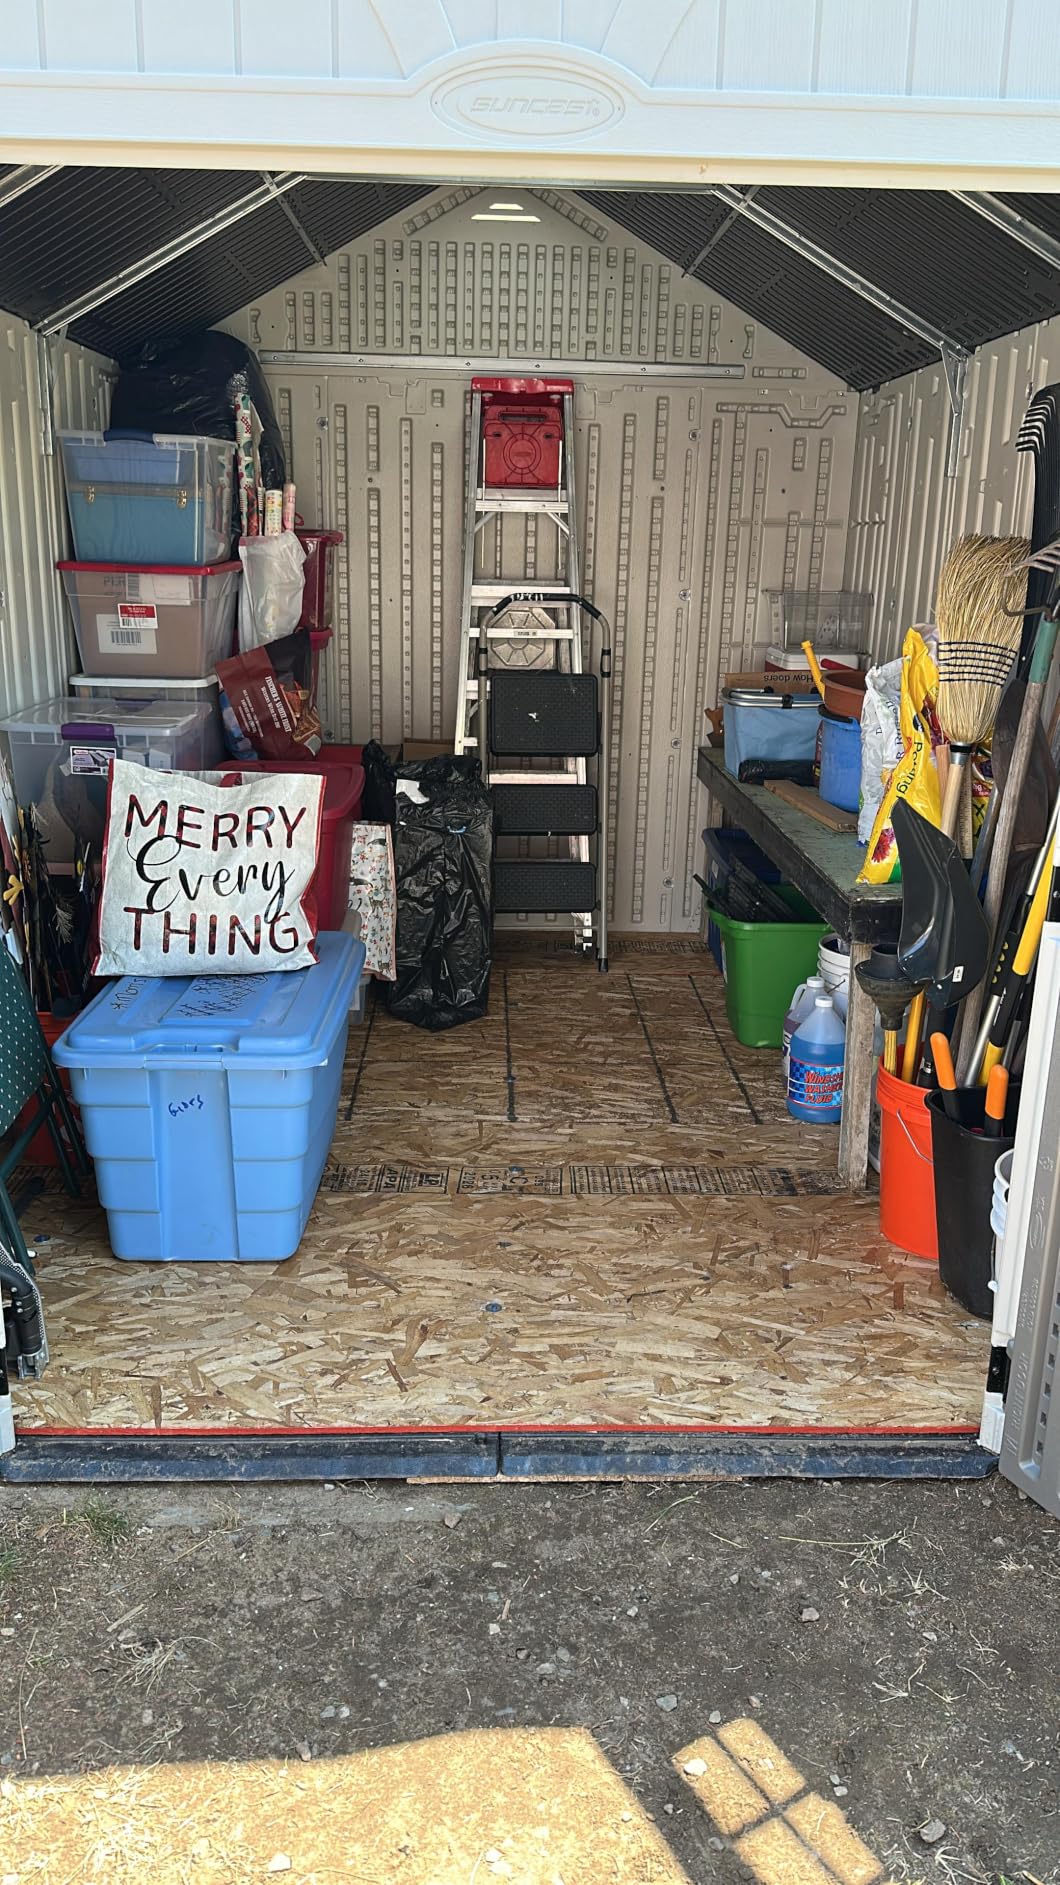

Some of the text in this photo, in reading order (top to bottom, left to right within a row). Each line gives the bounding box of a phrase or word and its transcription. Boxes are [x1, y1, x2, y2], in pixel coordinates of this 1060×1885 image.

[124, 794, 307, 851] MERRY
[126, 834, 296, 924] Every
[123, 906, 299, 955] THING
[383, 1166, 398, 1189] APA
